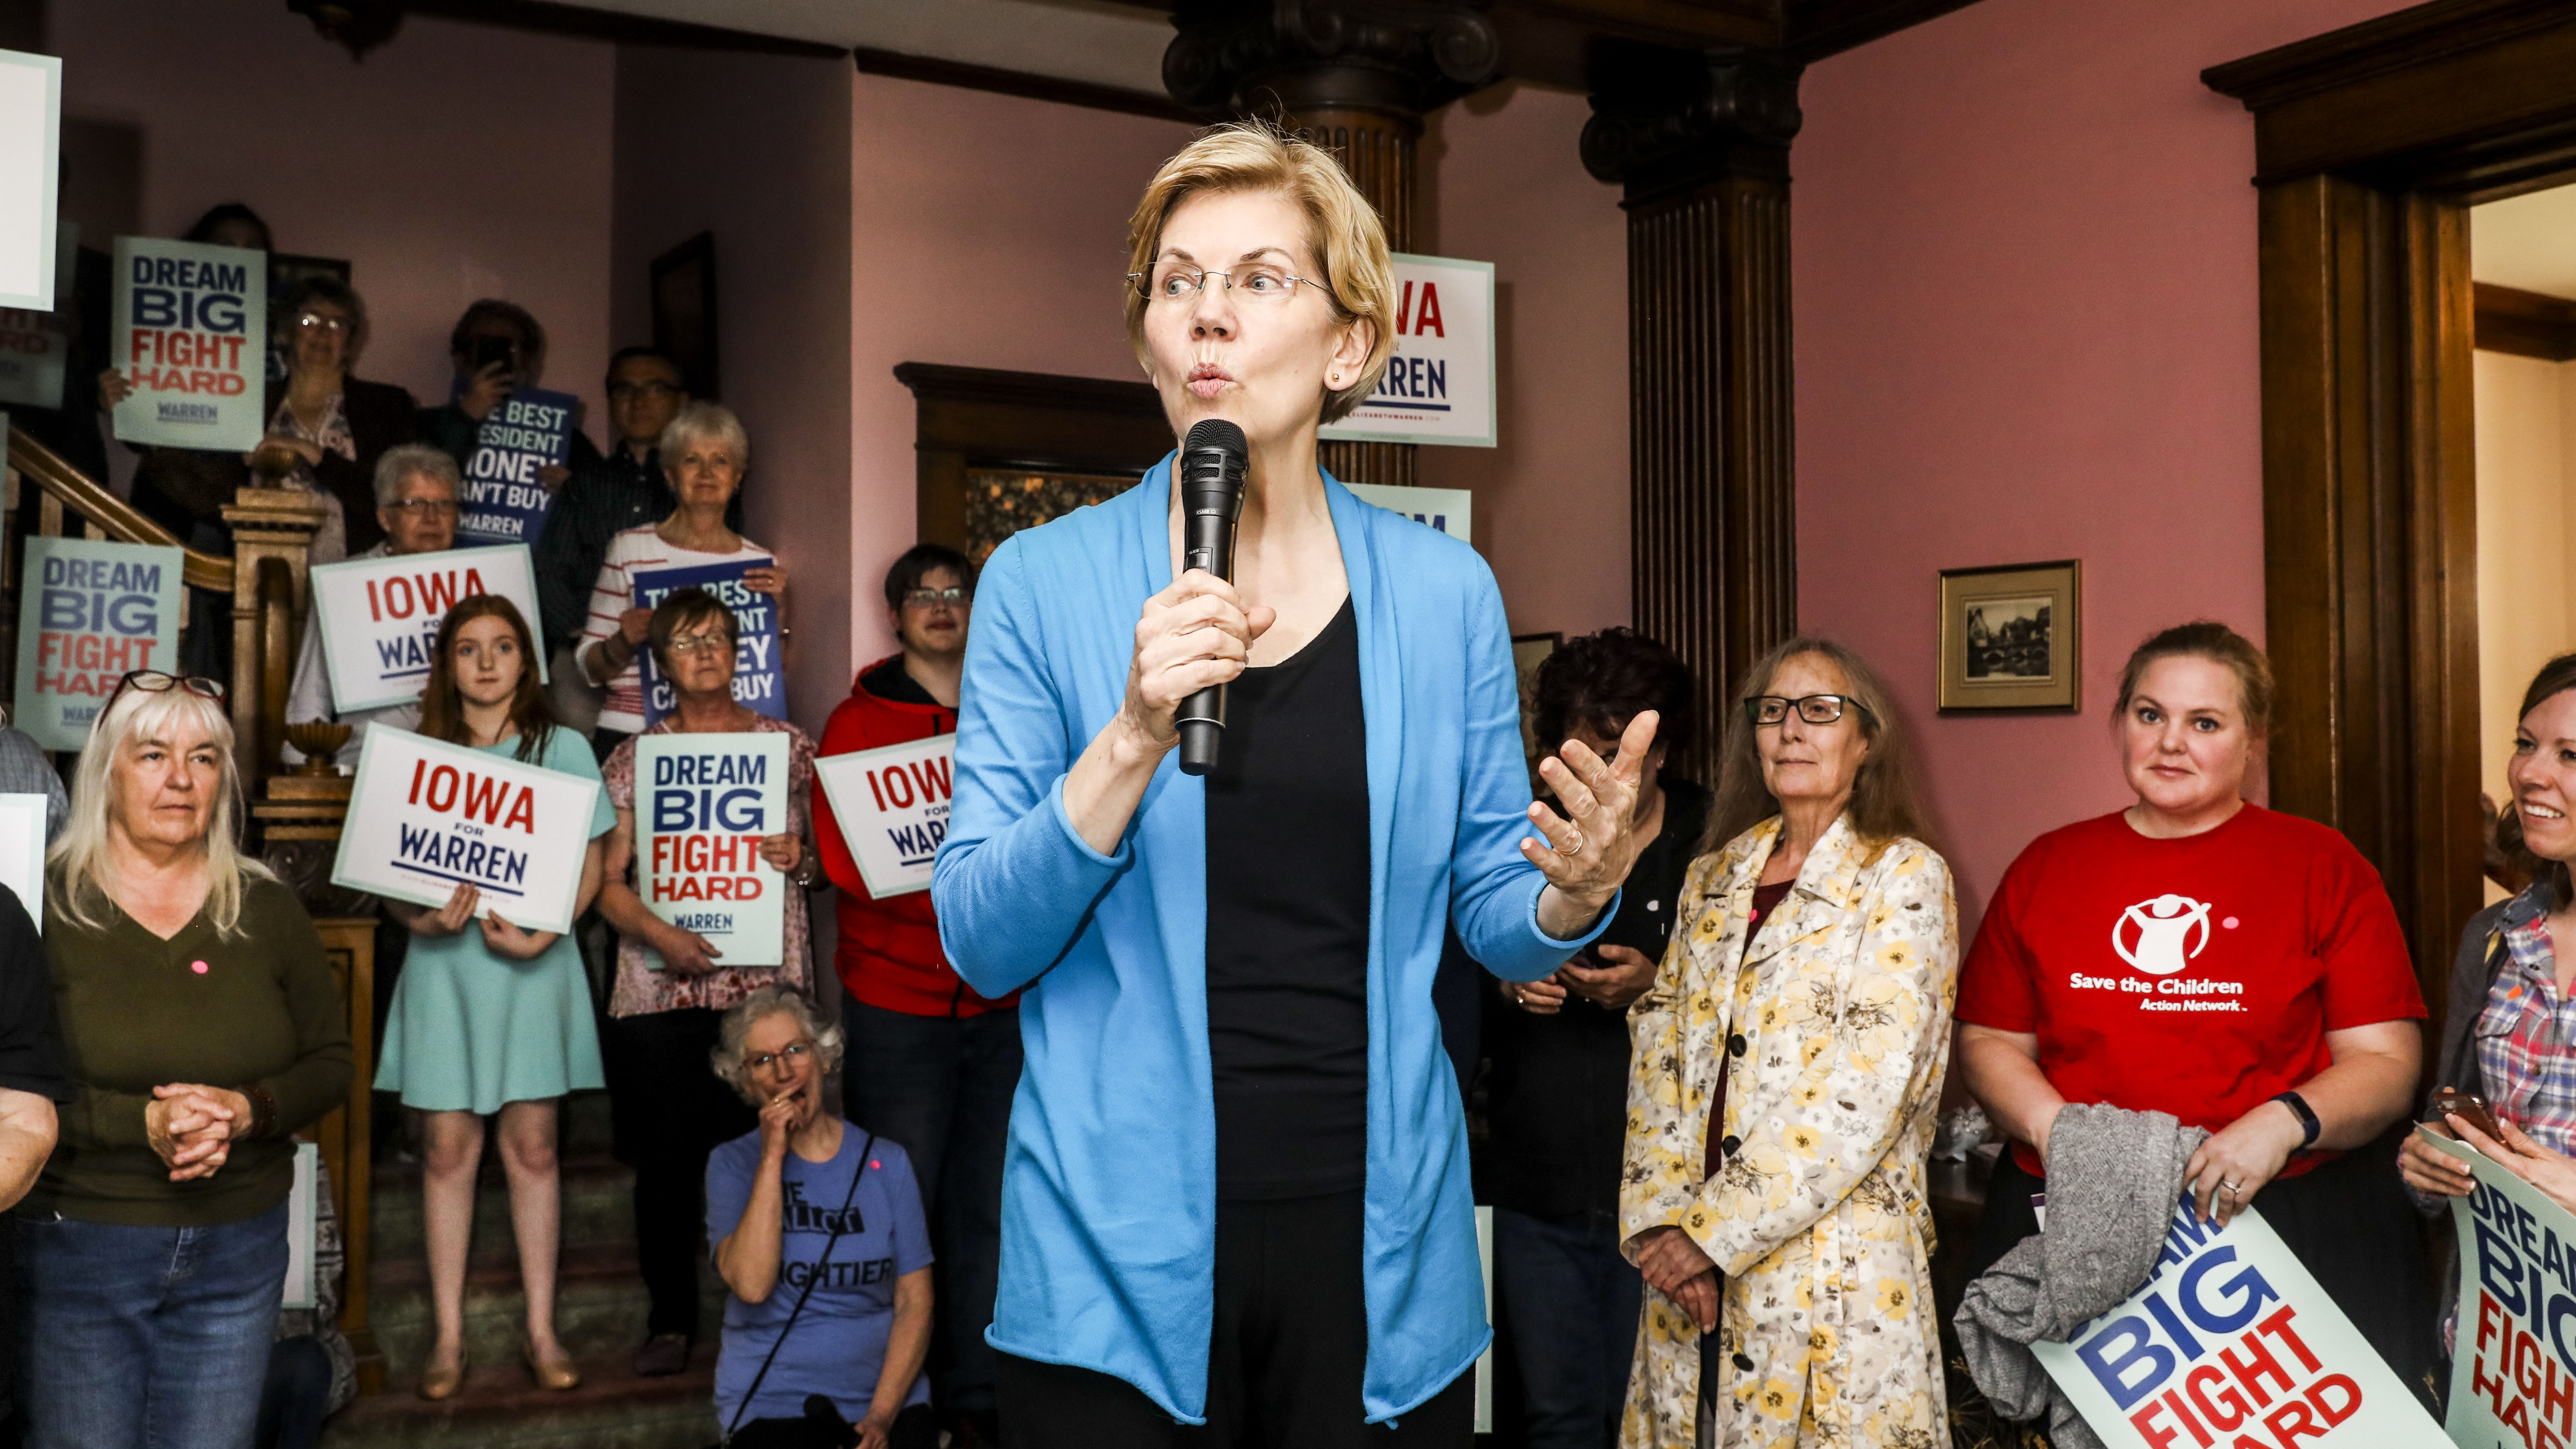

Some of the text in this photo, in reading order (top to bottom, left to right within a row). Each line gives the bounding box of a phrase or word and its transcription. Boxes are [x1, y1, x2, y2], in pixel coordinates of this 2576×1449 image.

[133, 256, 246, 293] DREAM
[132, 288, 246, 335] BIG
[131, 329, 246, 372] FIGHT
[129, 366, 246, 396] HARD
[1373, 356, 1446, 399] REN
[157, 401, 218, 421] WARREN
[506, 400, 568, 432] BEST
[478, 424, 563, 454] ESIDENT
[465, 447, 560, 487] ONE
[460, 480, 551, 511] AN'T BUY
[459, 513, 524, 535] WARREN
[44, 557, 161, 593] DREAM
[41, 588, 157, 635] BIG
[422, 619, 443, 628] FO
[37, 632, 158, 672] FIGHT
[377, 631, 438, 669] WAR
[35, 671, 124, 698] HAR
[730, 673, 774, 702] BUY
[655, 754, 766, 786] DREAM
[866, 756, 952, 812] IOW
[408, 758, 535, 835] IOWA
[653, 788, 764, 832] BIG
[455, 822, 485, 837] FOR
[887, 817, 949, 857] WAR
[401, 822, 528, 885] WARREN
[653, 835, 765, 874] FIGHT
[653, 877, 763, 903] HARD
[674, 913, 733, 929] WARREN
[2070, 972, 2243, 995] Save the Children
[2140, 998, 2240, 1012] Action Network
[779, 1257, 893, 1288] IGHTIER
[2075, 1245, 2280, 1412] BIG
[2128, 1303, 2323, 1449] FIGHT
[2476, 1287, 2575, 1444] FIGH
[2232, 1373, 2363, 1449] RD
[2472, 1353, 2564, 1449] HAR
